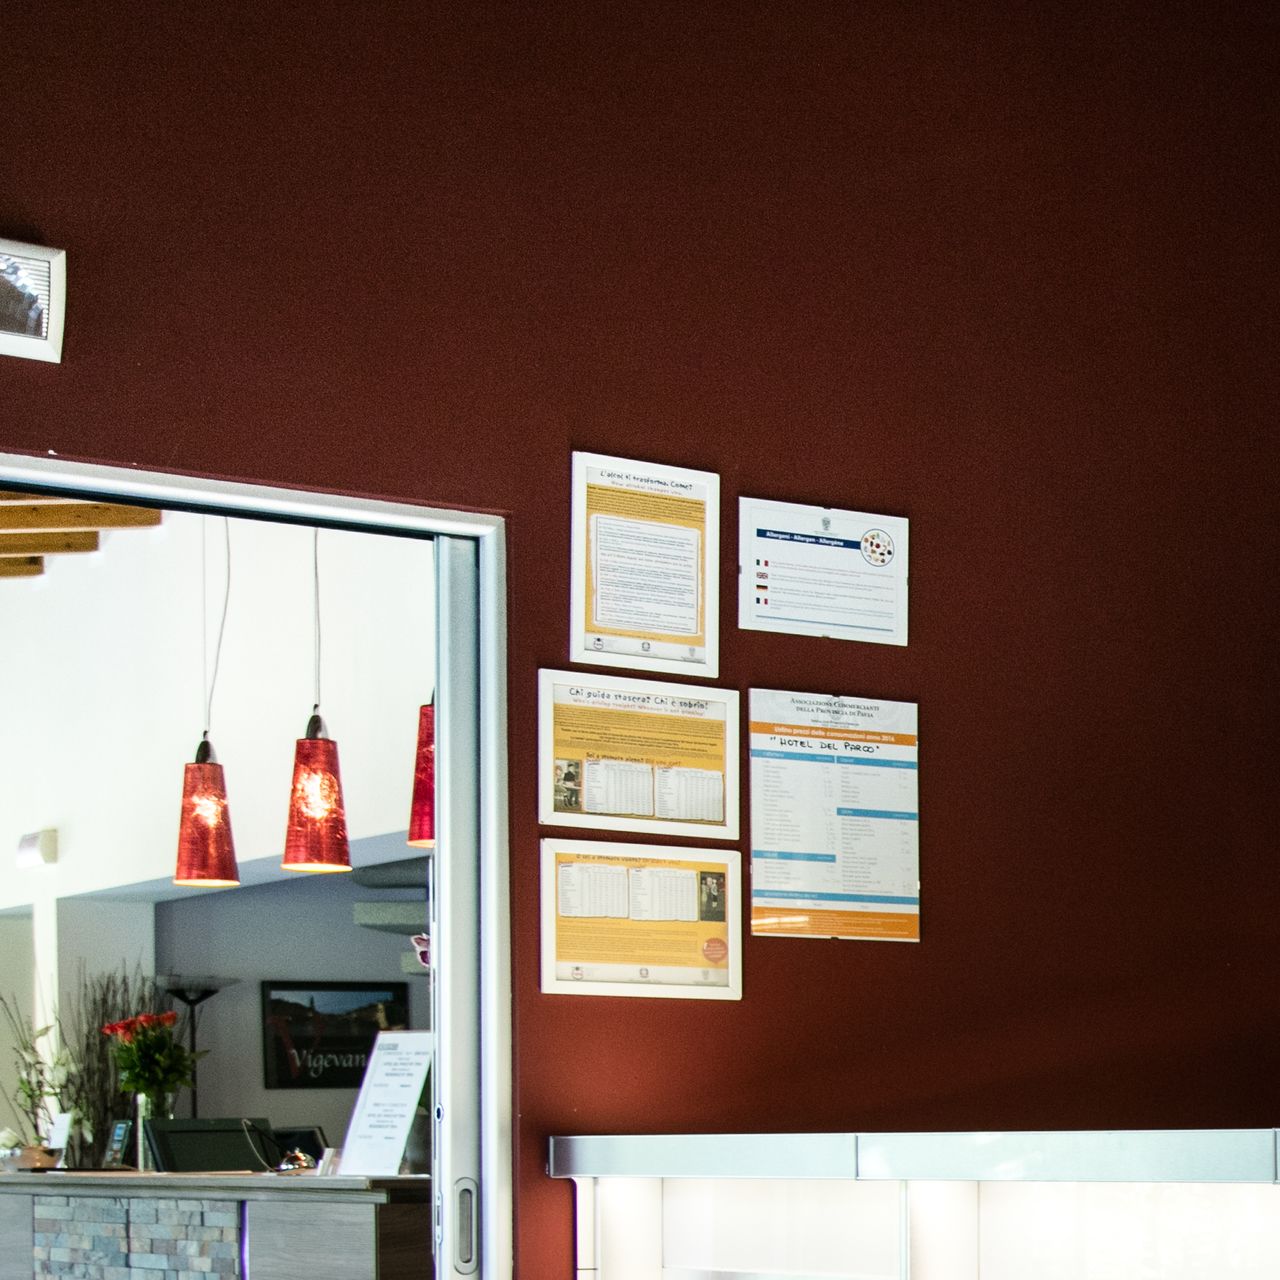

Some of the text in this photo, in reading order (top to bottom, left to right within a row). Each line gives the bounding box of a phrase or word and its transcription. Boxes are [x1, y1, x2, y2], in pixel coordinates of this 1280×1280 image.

[766, 531, 791, 541] Allergeni
[794, 534, 816, 544] Allergen
[569, 687, 584, 697] Chi
[586, 690, 611, 700] guida
[614, 693, 652, 704] stasera?
[654, 696, 669, 707] Chi
[820, 741, 839, 751] DEL
[289, 1046, 368, 1079] Vigevan
